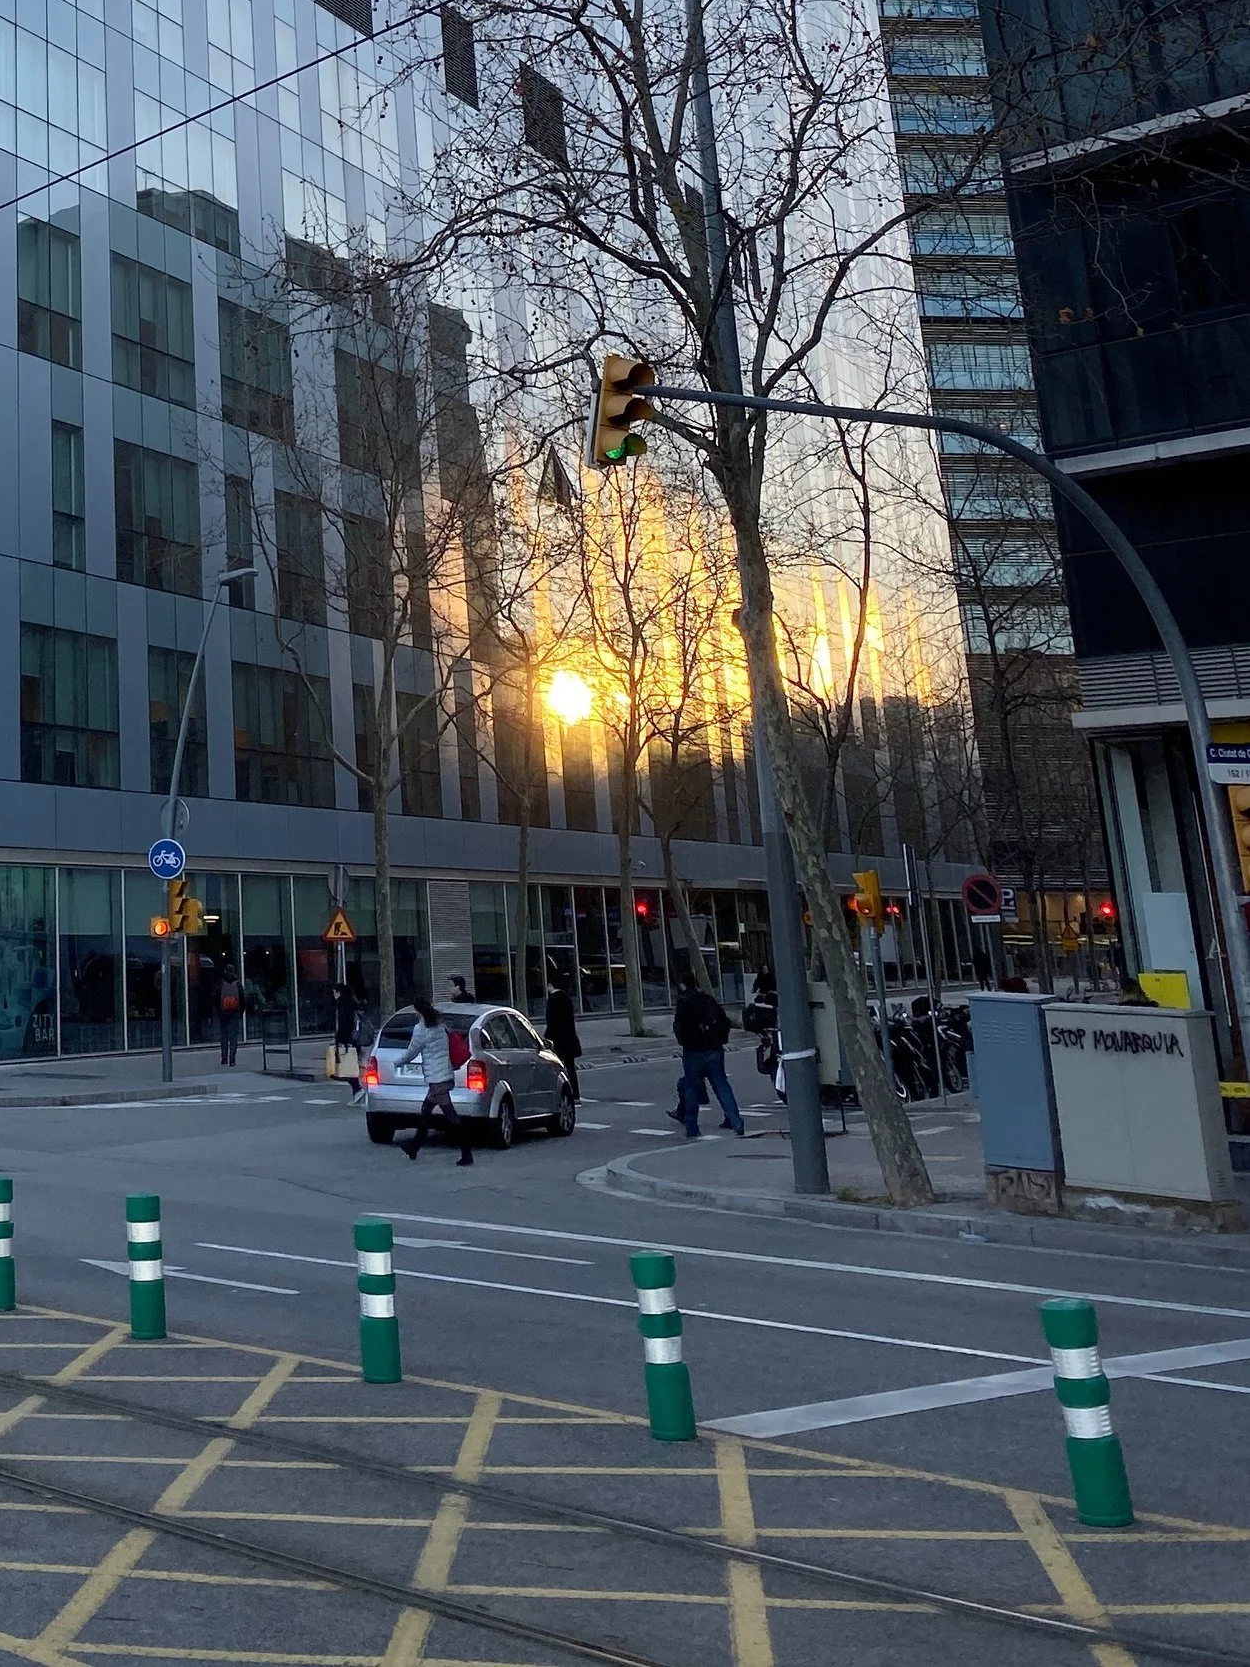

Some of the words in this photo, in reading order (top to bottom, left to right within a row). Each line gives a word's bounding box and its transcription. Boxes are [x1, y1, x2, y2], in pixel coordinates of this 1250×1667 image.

[32, 1013, 55, 1028] ZITY
[34, 1027, 55, 1043] BAR
[1051, 1027, 1086, 1051] STOP
[1093, 1030, 1184, 1059] MONARQUIA
